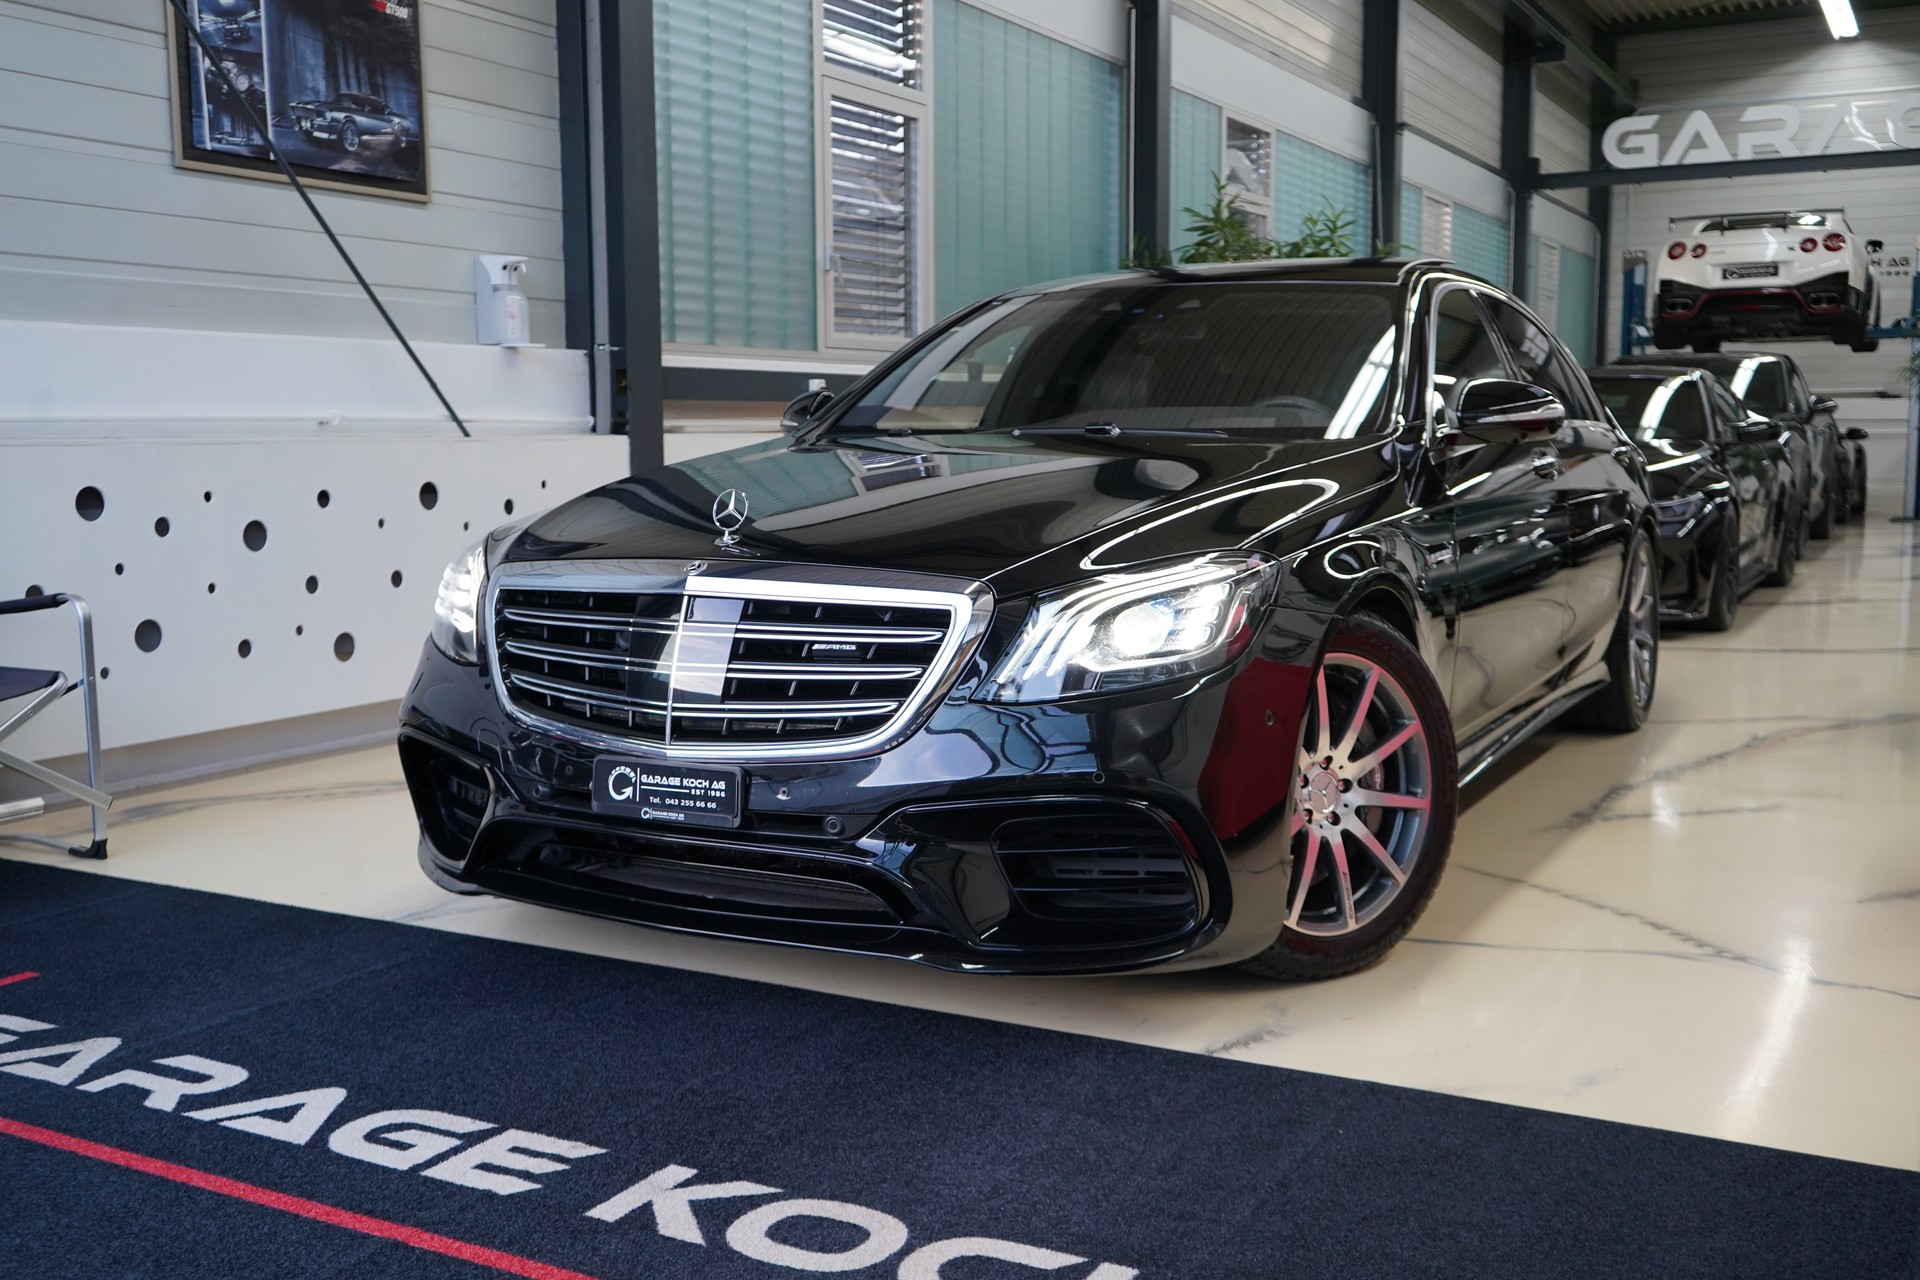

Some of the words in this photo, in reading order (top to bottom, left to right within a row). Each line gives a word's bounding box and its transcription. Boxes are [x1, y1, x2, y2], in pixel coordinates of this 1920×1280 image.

[640, 774, 681, 786] GARAGE
[682, 778, 709, 789] KOCH
[711, 780, 726, 790] AG
[707, 790, 726, 798] 1986
[649, 796, 661, 804] Tel.
[680, 799, 694, 807] 255
[695, 800, 705, 808] 66
[707, 801, 717, 809] 66
